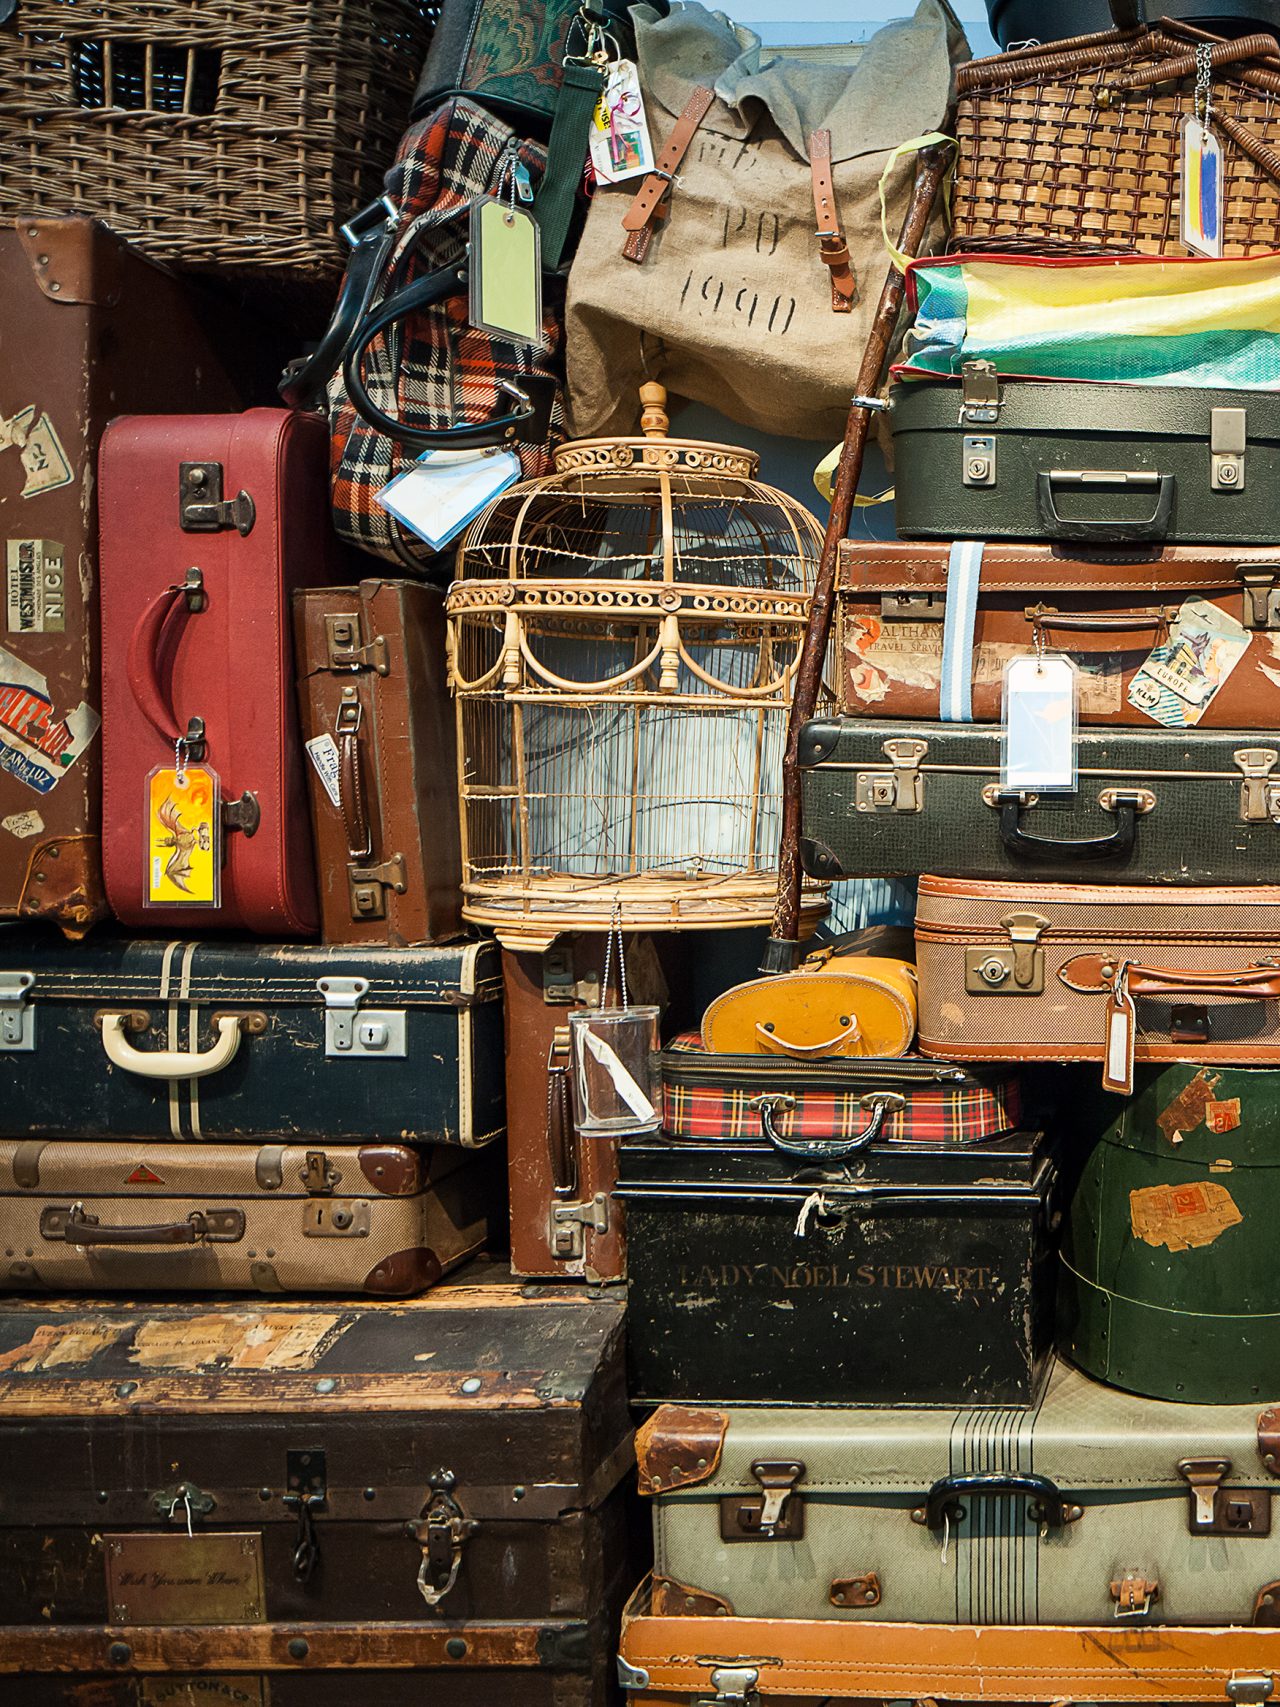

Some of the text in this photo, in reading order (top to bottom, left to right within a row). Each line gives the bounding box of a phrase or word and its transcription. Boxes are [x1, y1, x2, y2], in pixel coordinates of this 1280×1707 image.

[679, 269, 796, 335] 1990
[45, 557, 62, 618] NICE
[881, 625, 942, 638] ALTHAM
[868, 641, 943, 652] TRAVEL SERVIC
[1156, 667, 1189, 694] EUROPE
[1135, 687, 1156, 704] KLM
[30, 765, 50, 787] LUZ
[323, 748, 339, 779] Frag
[679, 1263, 757, 1287] LADY
[855, 1264, 992, 1290] STEWART
